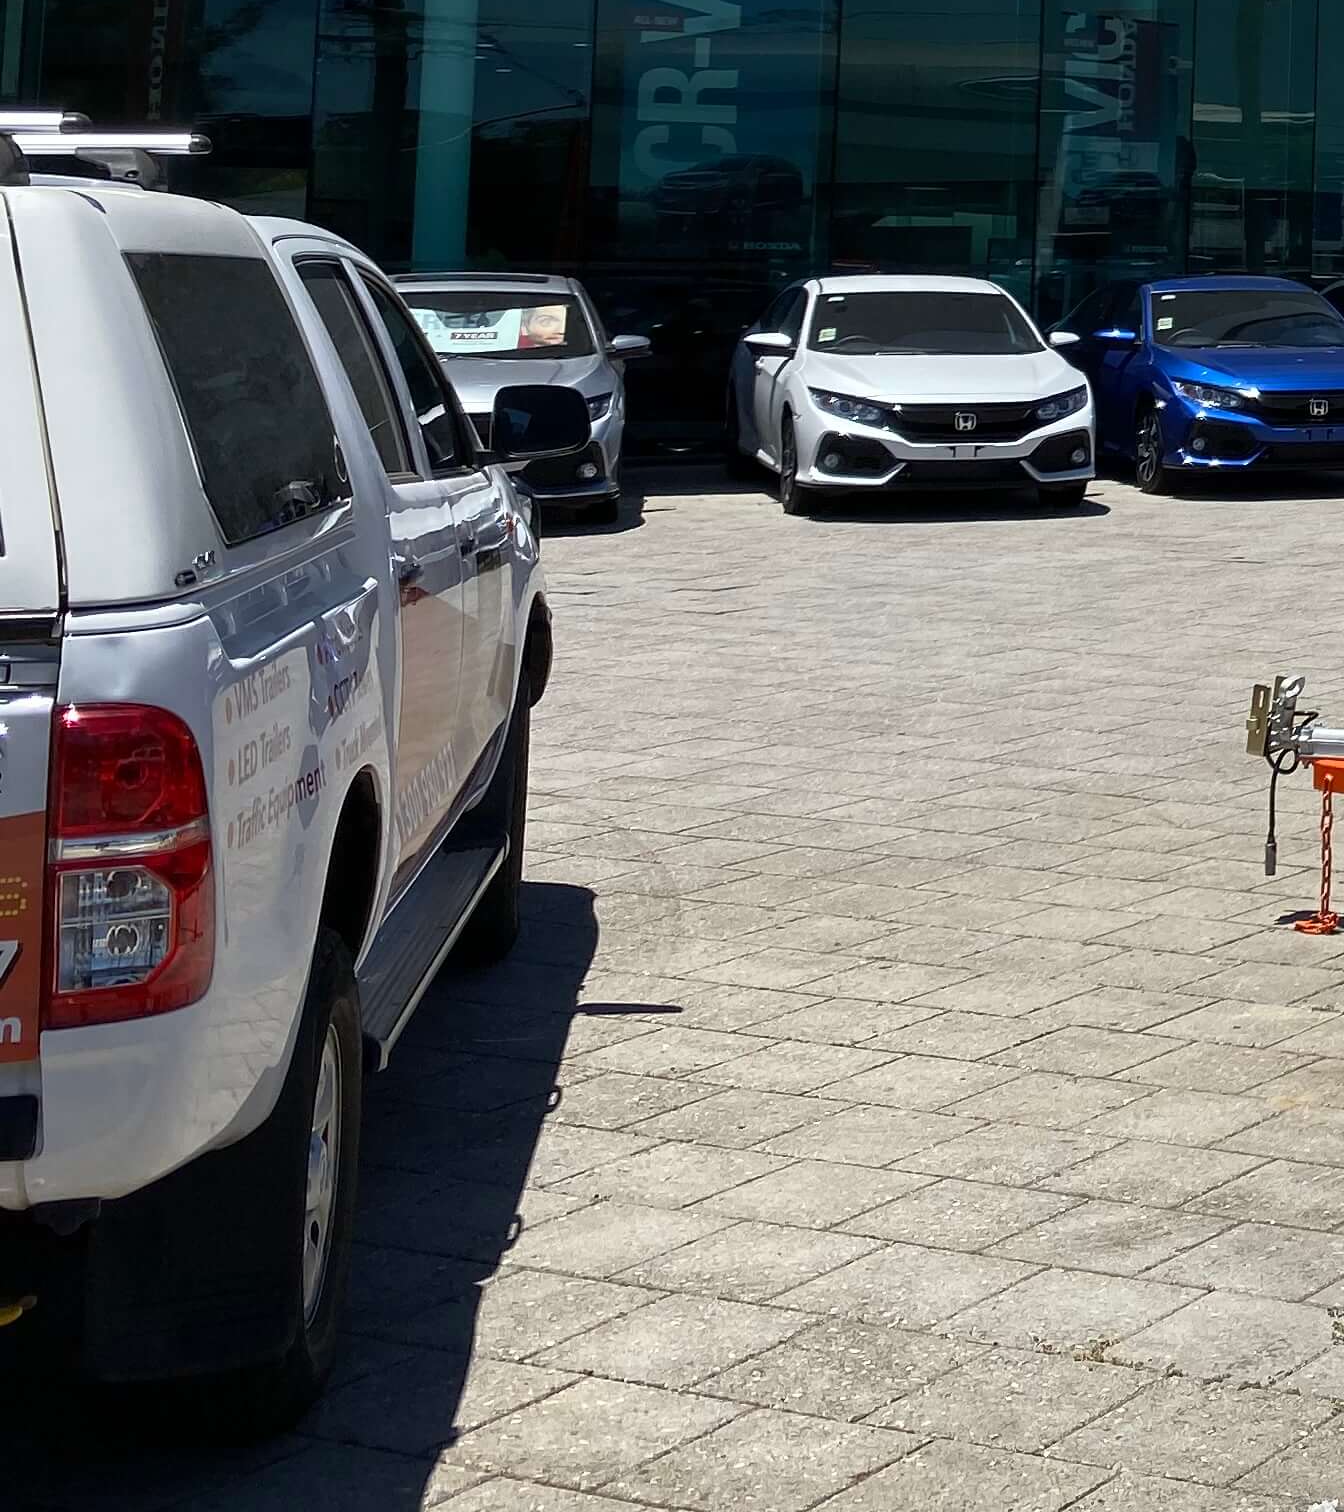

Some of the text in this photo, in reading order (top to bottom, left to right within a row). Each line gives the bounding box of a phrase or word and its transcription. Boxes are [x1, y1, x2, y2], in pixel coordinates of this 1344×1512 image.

[234, 672, 259, 720] VMS
[238, 742, 258, 785] LED
[237, 759, 328, 849] Traffic Equipment
